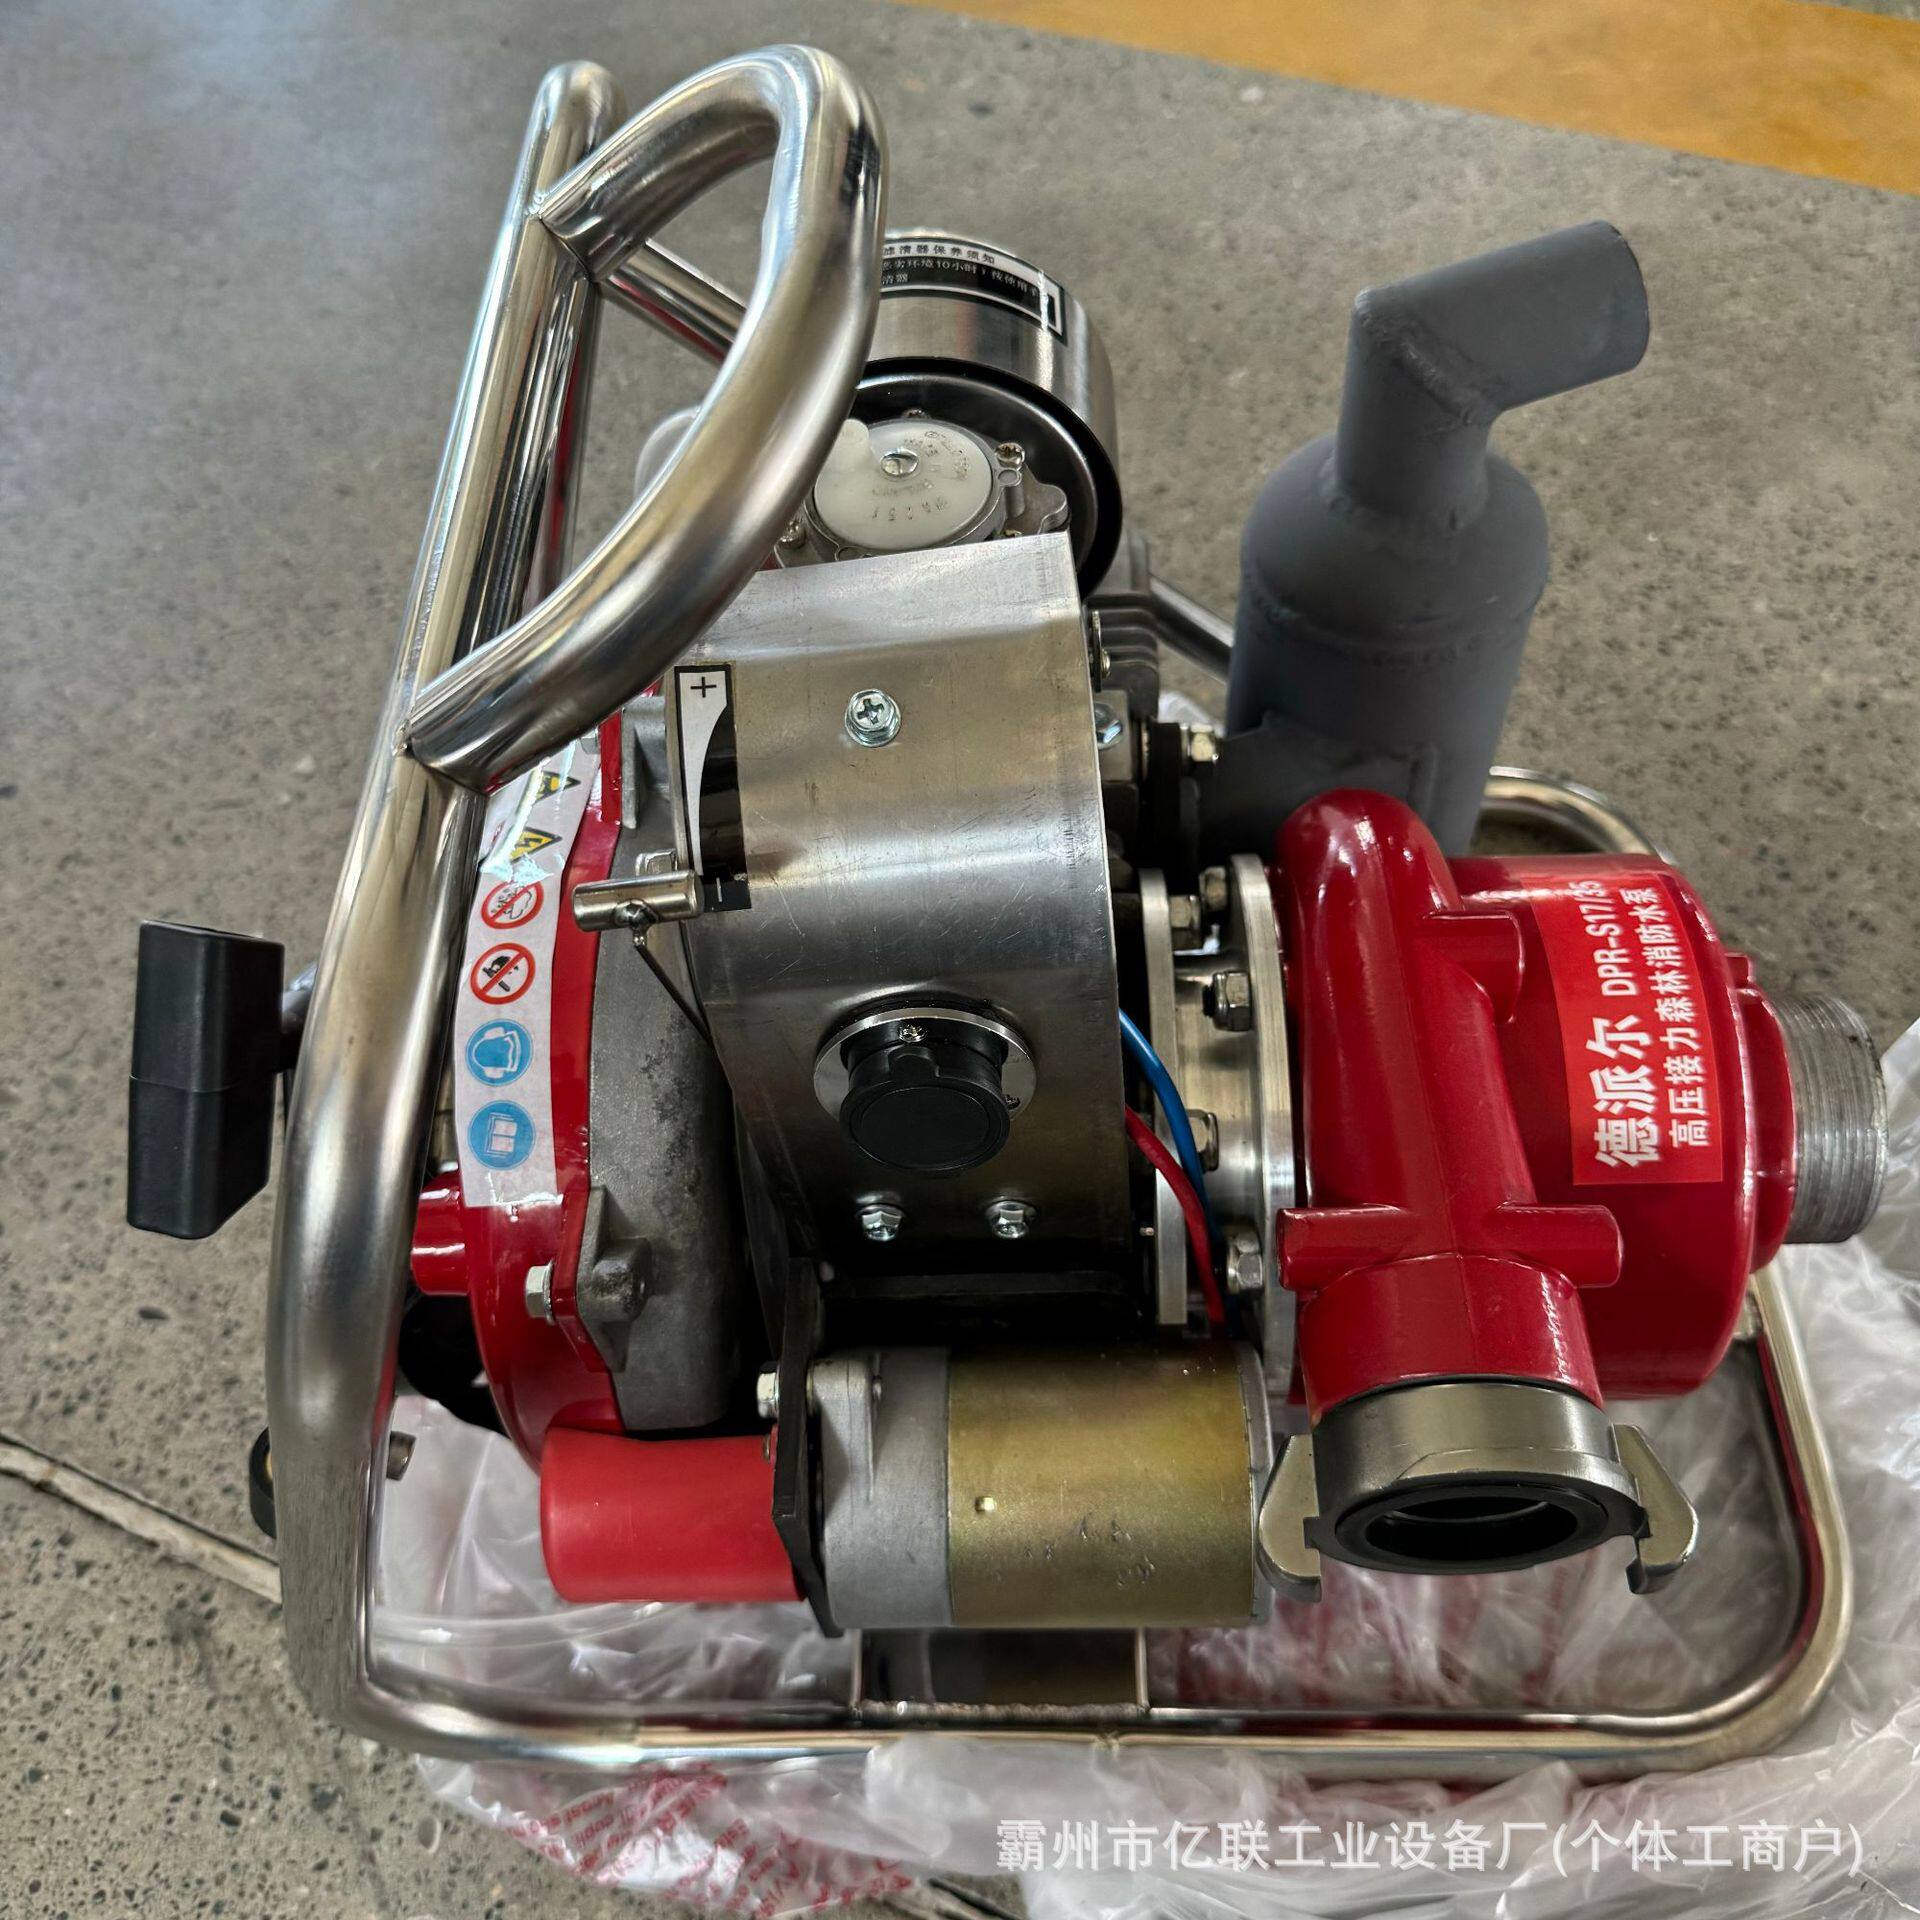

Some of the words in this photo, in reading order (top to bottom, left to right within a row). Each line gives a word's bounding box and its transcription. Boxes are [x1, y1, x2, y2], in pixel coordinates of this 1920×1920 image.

[1570, 880, 1637, 996] DPR-S17/35
[1586, 1016, 1661, 1168] 德派尔
[1619, 887, 1709, 1148] 高压接力森林消防水泵
